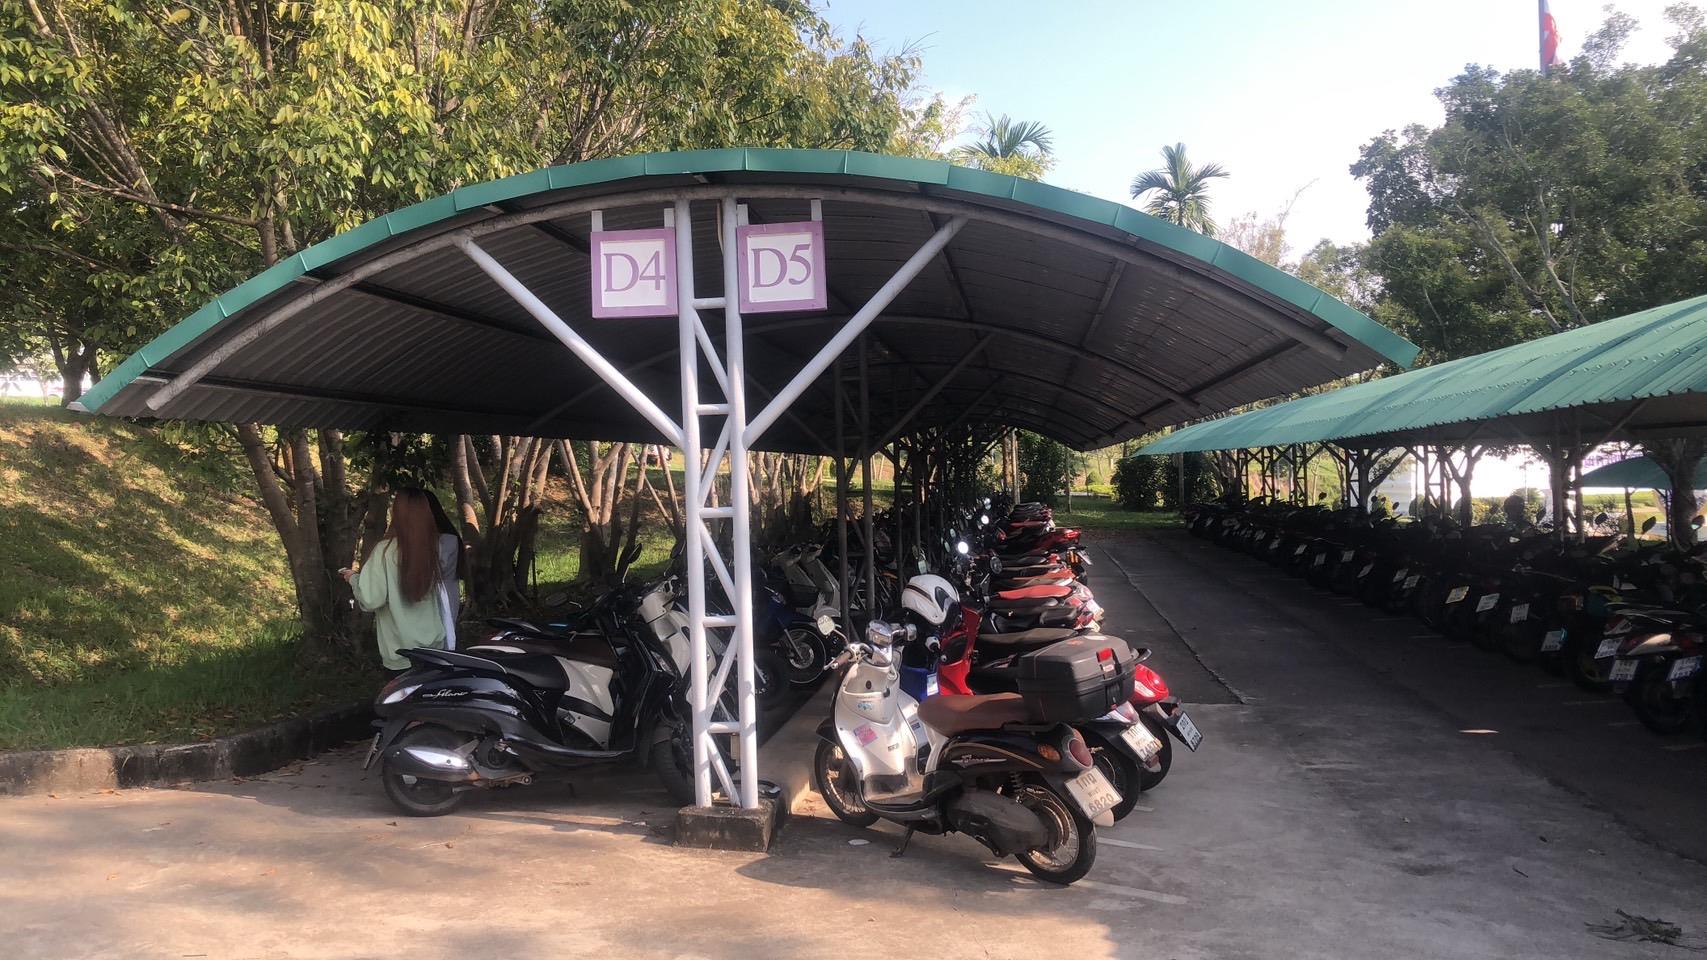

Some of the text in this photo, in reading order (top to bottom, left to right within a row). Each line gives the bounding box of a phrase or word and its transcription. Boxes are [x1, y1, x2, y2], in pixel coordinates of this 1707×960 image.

[603, 250, 666, 292] D4
[751, 243, 812, 289] D5
[1088, 792, 1114, 812] 6820
